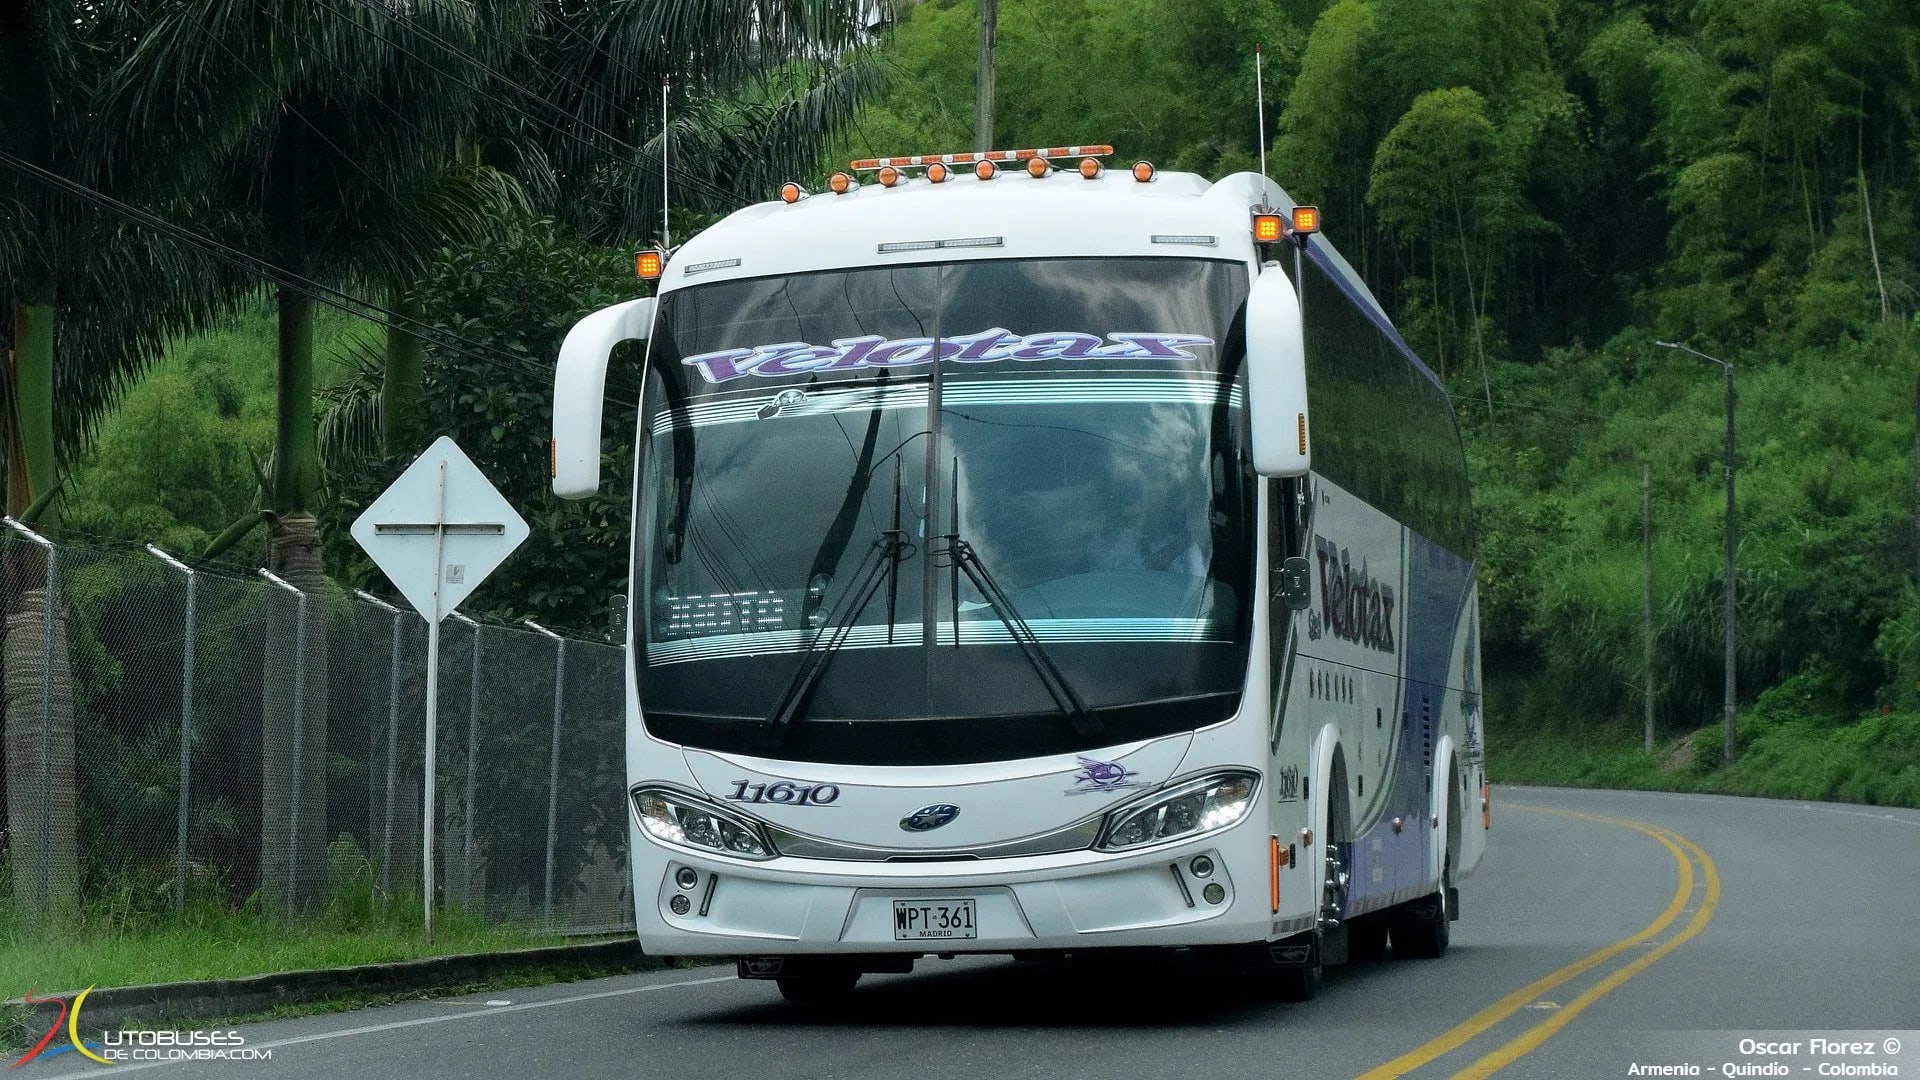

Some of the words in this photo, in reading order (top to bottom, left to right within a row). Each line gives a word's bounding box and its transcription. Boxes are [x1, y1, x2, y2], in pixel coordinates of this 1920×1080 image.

[681, 327, 1215, 384] Velotax
[1315, 532, 1395, 655] Velotax
[724, 778, 841, 807] 11610
[919, 930, 953, 938] MADRID
